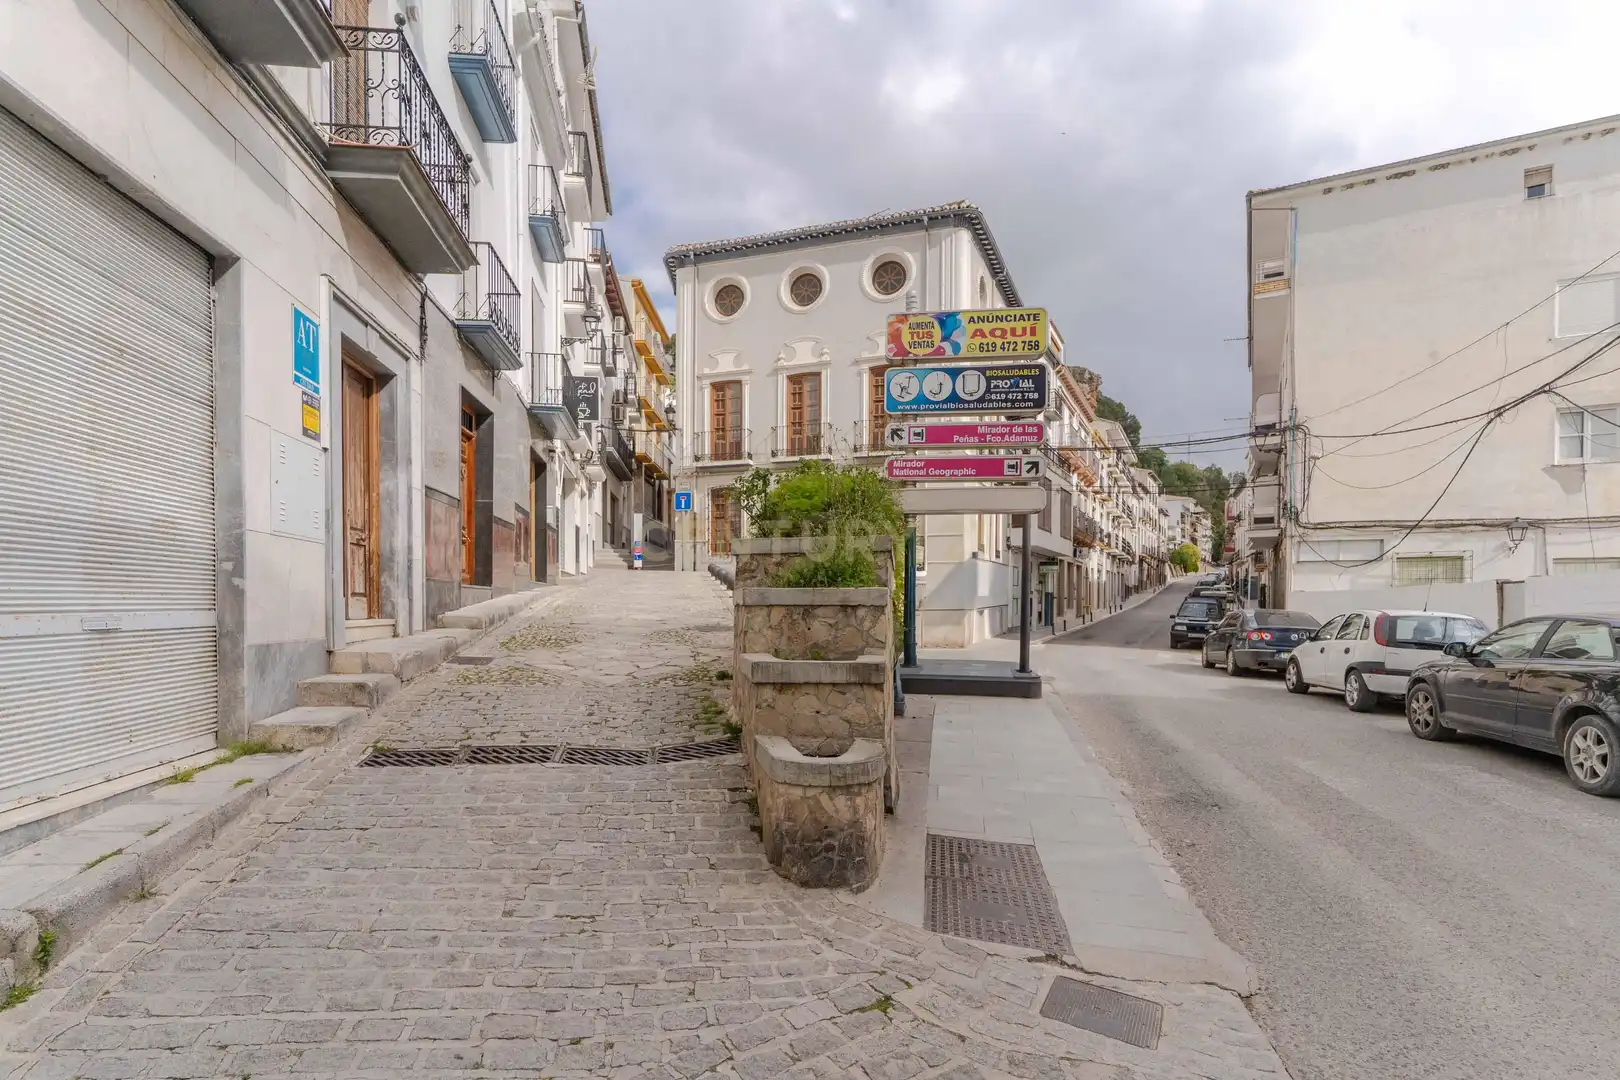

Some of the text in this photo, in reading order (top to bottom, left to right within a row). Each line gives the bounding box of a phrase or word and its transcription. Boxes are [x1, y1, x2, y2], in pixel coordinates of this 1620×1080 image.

[967, 313, 1041, 324] ANÚNCIATE
[908, 321, 935, 331] AUMENTA
[297, 317, 317, 353] AT
[908, 330, 935, 340] TUS
[969, 323, 1038, 340] AQUÍ
[908, 340, 935, 350] VENTAS
[978, 340, 1040, 353] 619 472 758
[985, 368, 1040, 377] BIOSALUDABLES
[1007, 392, 1022, 400] 472
[1023, 392, 1039, 400] 758
[897, 401, 1034, 411] www.provialbiosaludables.com
[977, 424, 1038, 434] Mirador de las
[953, 435, 979, 444] Peñas
[986, 434, 1038, 444] Fco.Adamuz
[893, 460, 925, 468] Mirador
[893, 467, 977, 477] National Geographic
